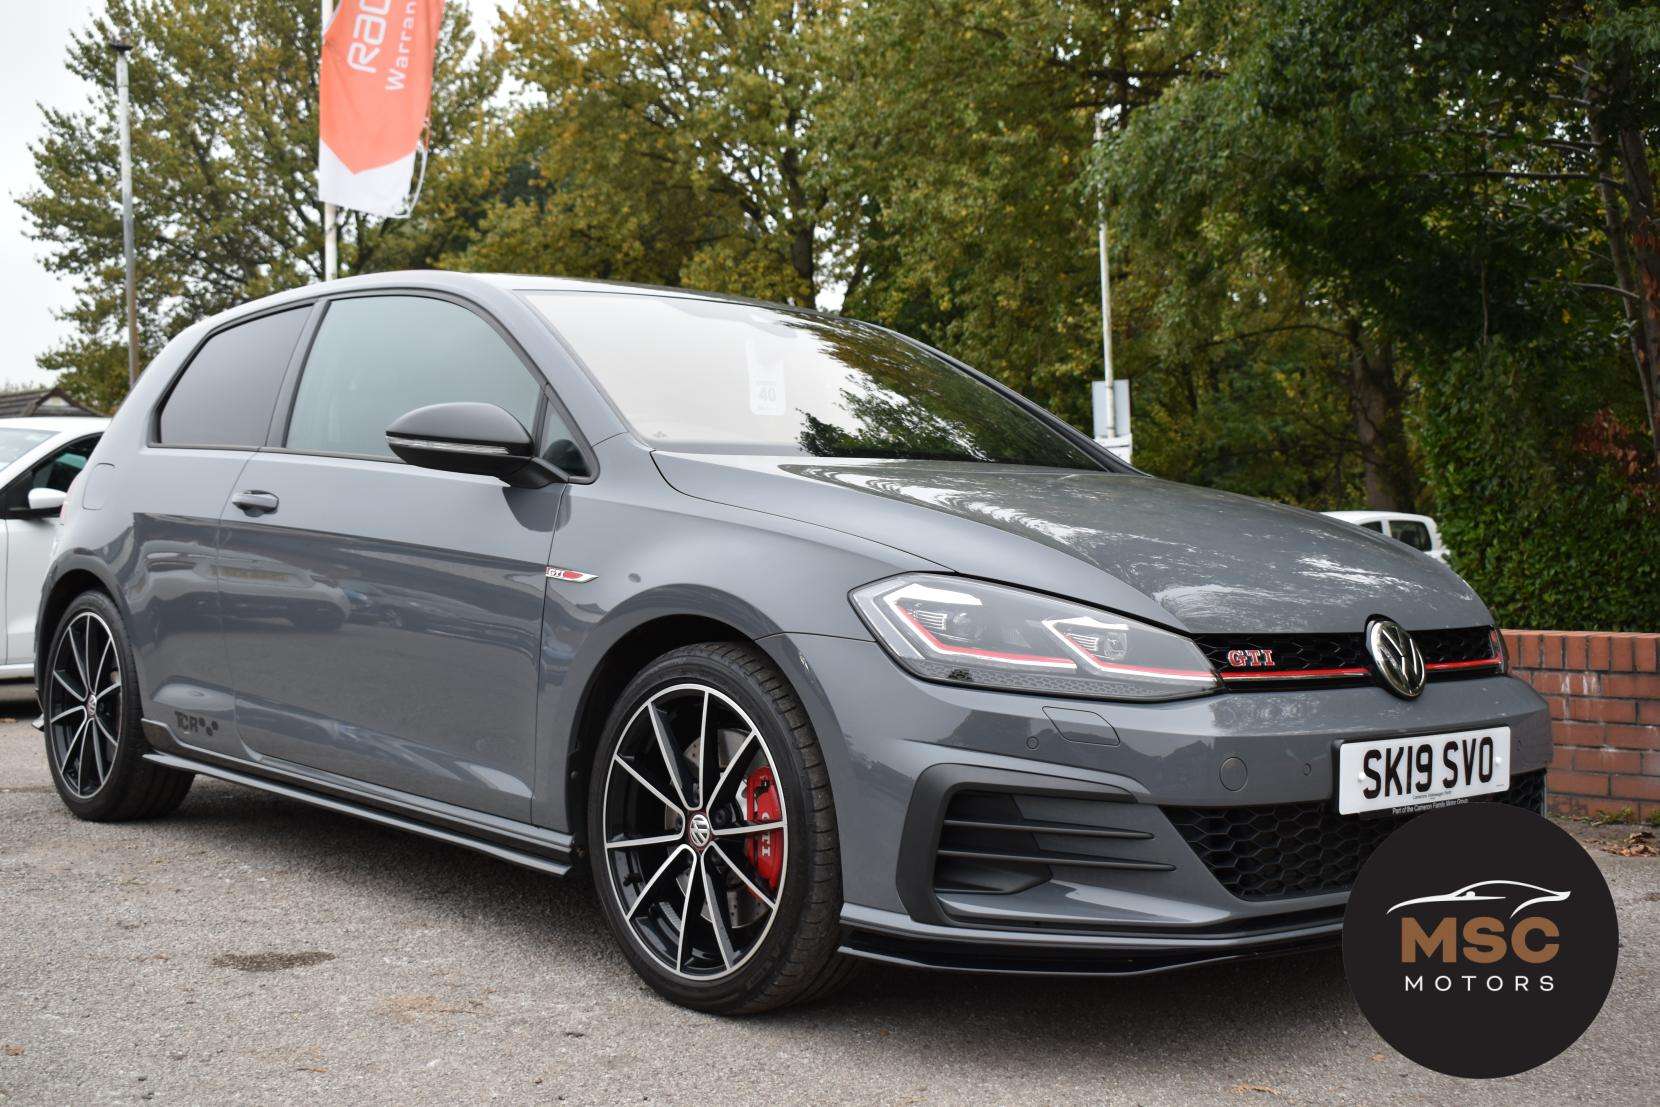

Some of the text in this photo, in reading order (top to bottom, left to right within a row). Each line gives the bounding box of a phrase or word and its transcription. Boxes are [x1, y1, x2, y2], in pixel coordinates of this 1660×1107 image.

[547, 567, 566, 578] GTI
[1227, 649, 1276, 667] GTI
[174, 710, 199, 732] TCR
[1362, 736, 1494, 799] SK19 SVO
